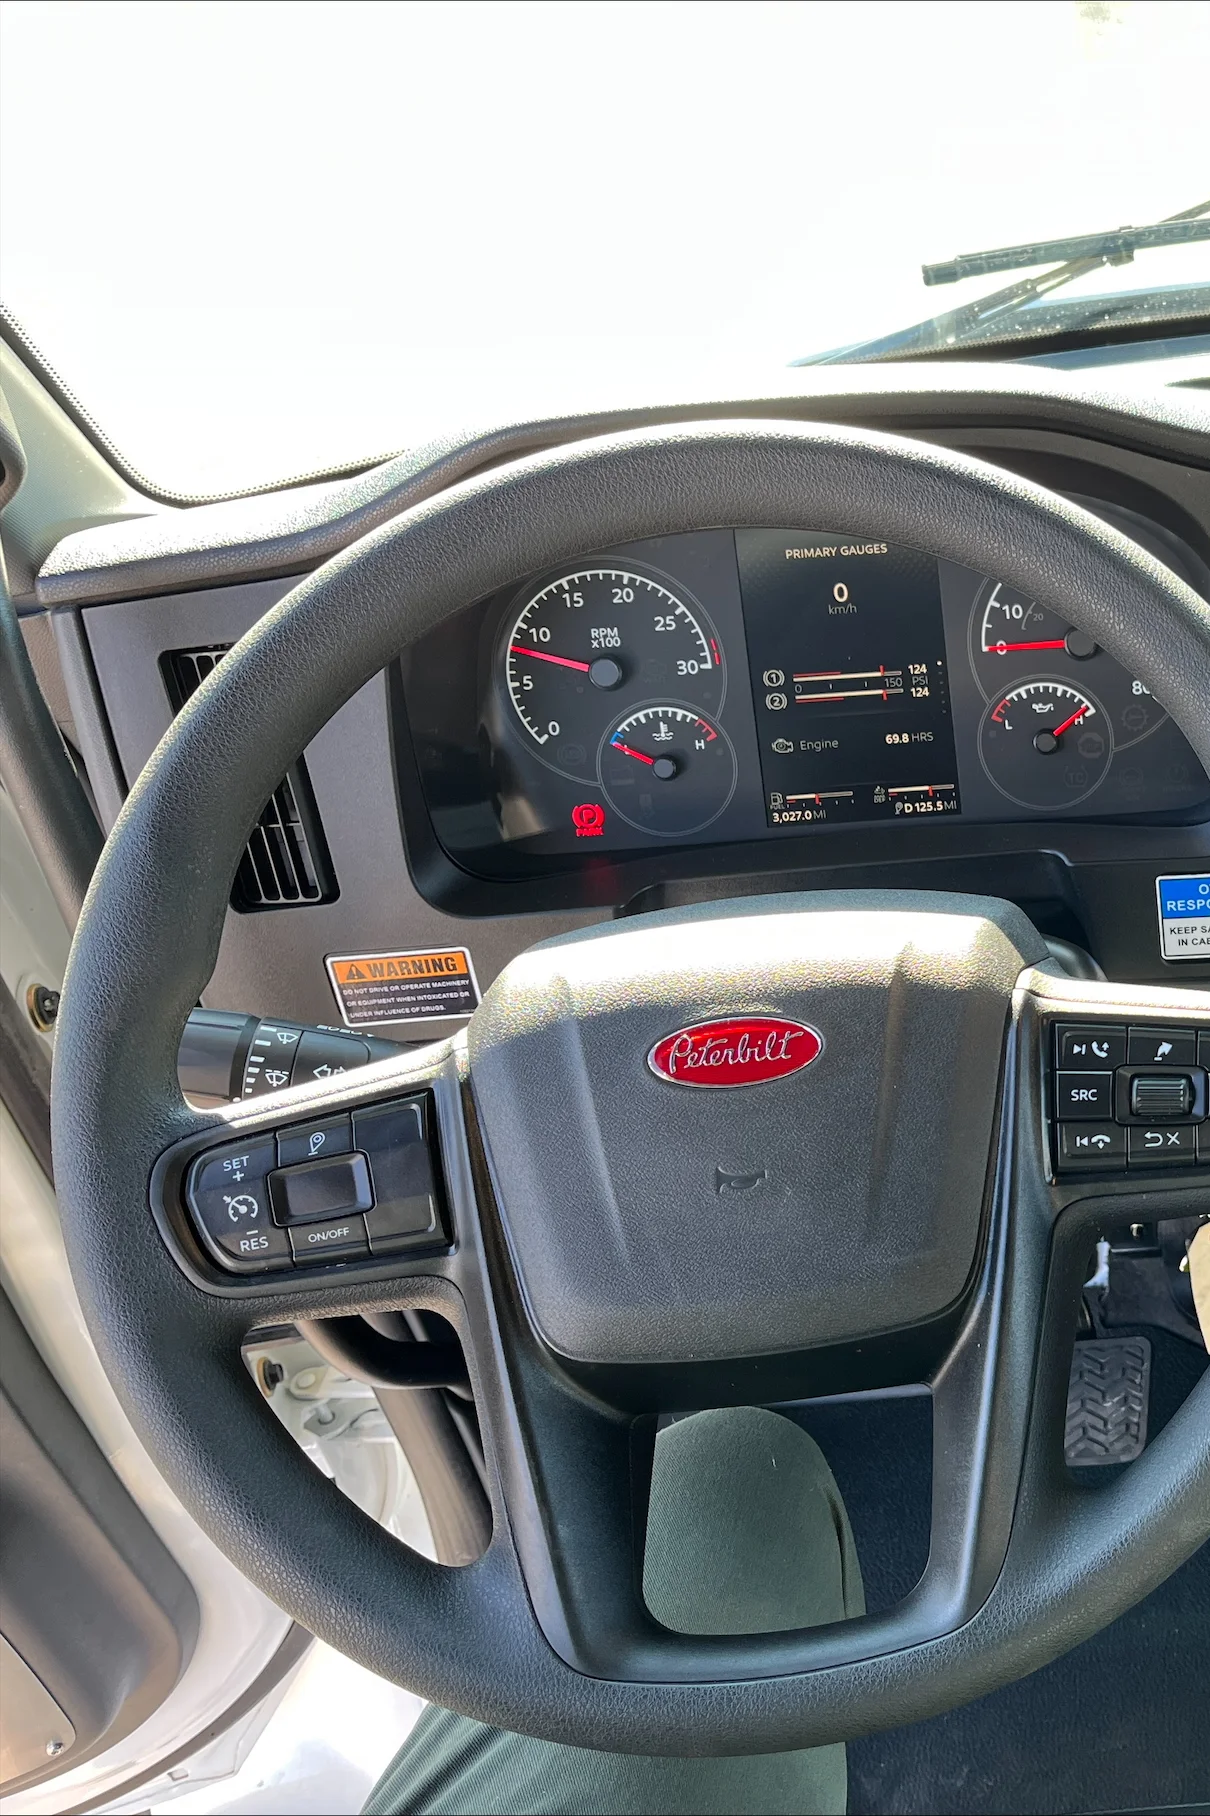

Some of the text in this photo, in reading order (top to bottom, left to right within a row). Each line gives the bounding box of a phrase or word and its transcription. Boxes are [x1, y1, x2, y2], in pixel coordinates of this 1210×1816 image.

[786, 544, 888, 559] PRIMARY GAUGES
[612, 588, 634, 603] 20
[833, 583, 848, 602] 0
[562, 593, 584, 607] 15
[829, 604, 857, 614] km/h
[1002, 604, 1023, 620] 10
[654, 616, 676, 630] 25
[1033, 613, 1043, 621] 20
[529, 627, 550, 642] 10
[591, 627, 618, 639] RPM
[592, 636, 620, 648] x100
[677, 660, 698, 675] 30
[908, 664, 927, 675] 124
[523, 676, 533, 690] 5
[795, 676, 928, 693] 0 150 PSI
[911, 687, 929, 697] 124
[1005, 720, 1012, 729] L
[1075, 716, 1083, 725] H
[549, 721, 559, 735] 0
[696, 740, 704, 750] H
[800, 732, 933, 752] Engine 69.8 HRS
[915, 801, 943, 812] 125.5
[945, 801, 957, 810] MI
[773, 810, 826, 823] 3,027.0 MI
[1170, 926, 1197, 935] KEEP
[367, 957, 458, 978] WARNING
[401, 982, 431, 991] OPERATE
[432, 979, 469, 988] MACHINERY
[358, 998, 395, 1006] EQUIPMENT
[417, 992, 458, 1001] INTOXICATED
[669, 1031, 803, 1074] Peterbilt
[1071, 1089, 1097, 1101] SRC
[223, 1156, 249, 1172] SET
[308, 1227, 350, 1243] ON/OFF
[240, 1237, 268, 1252] RES
